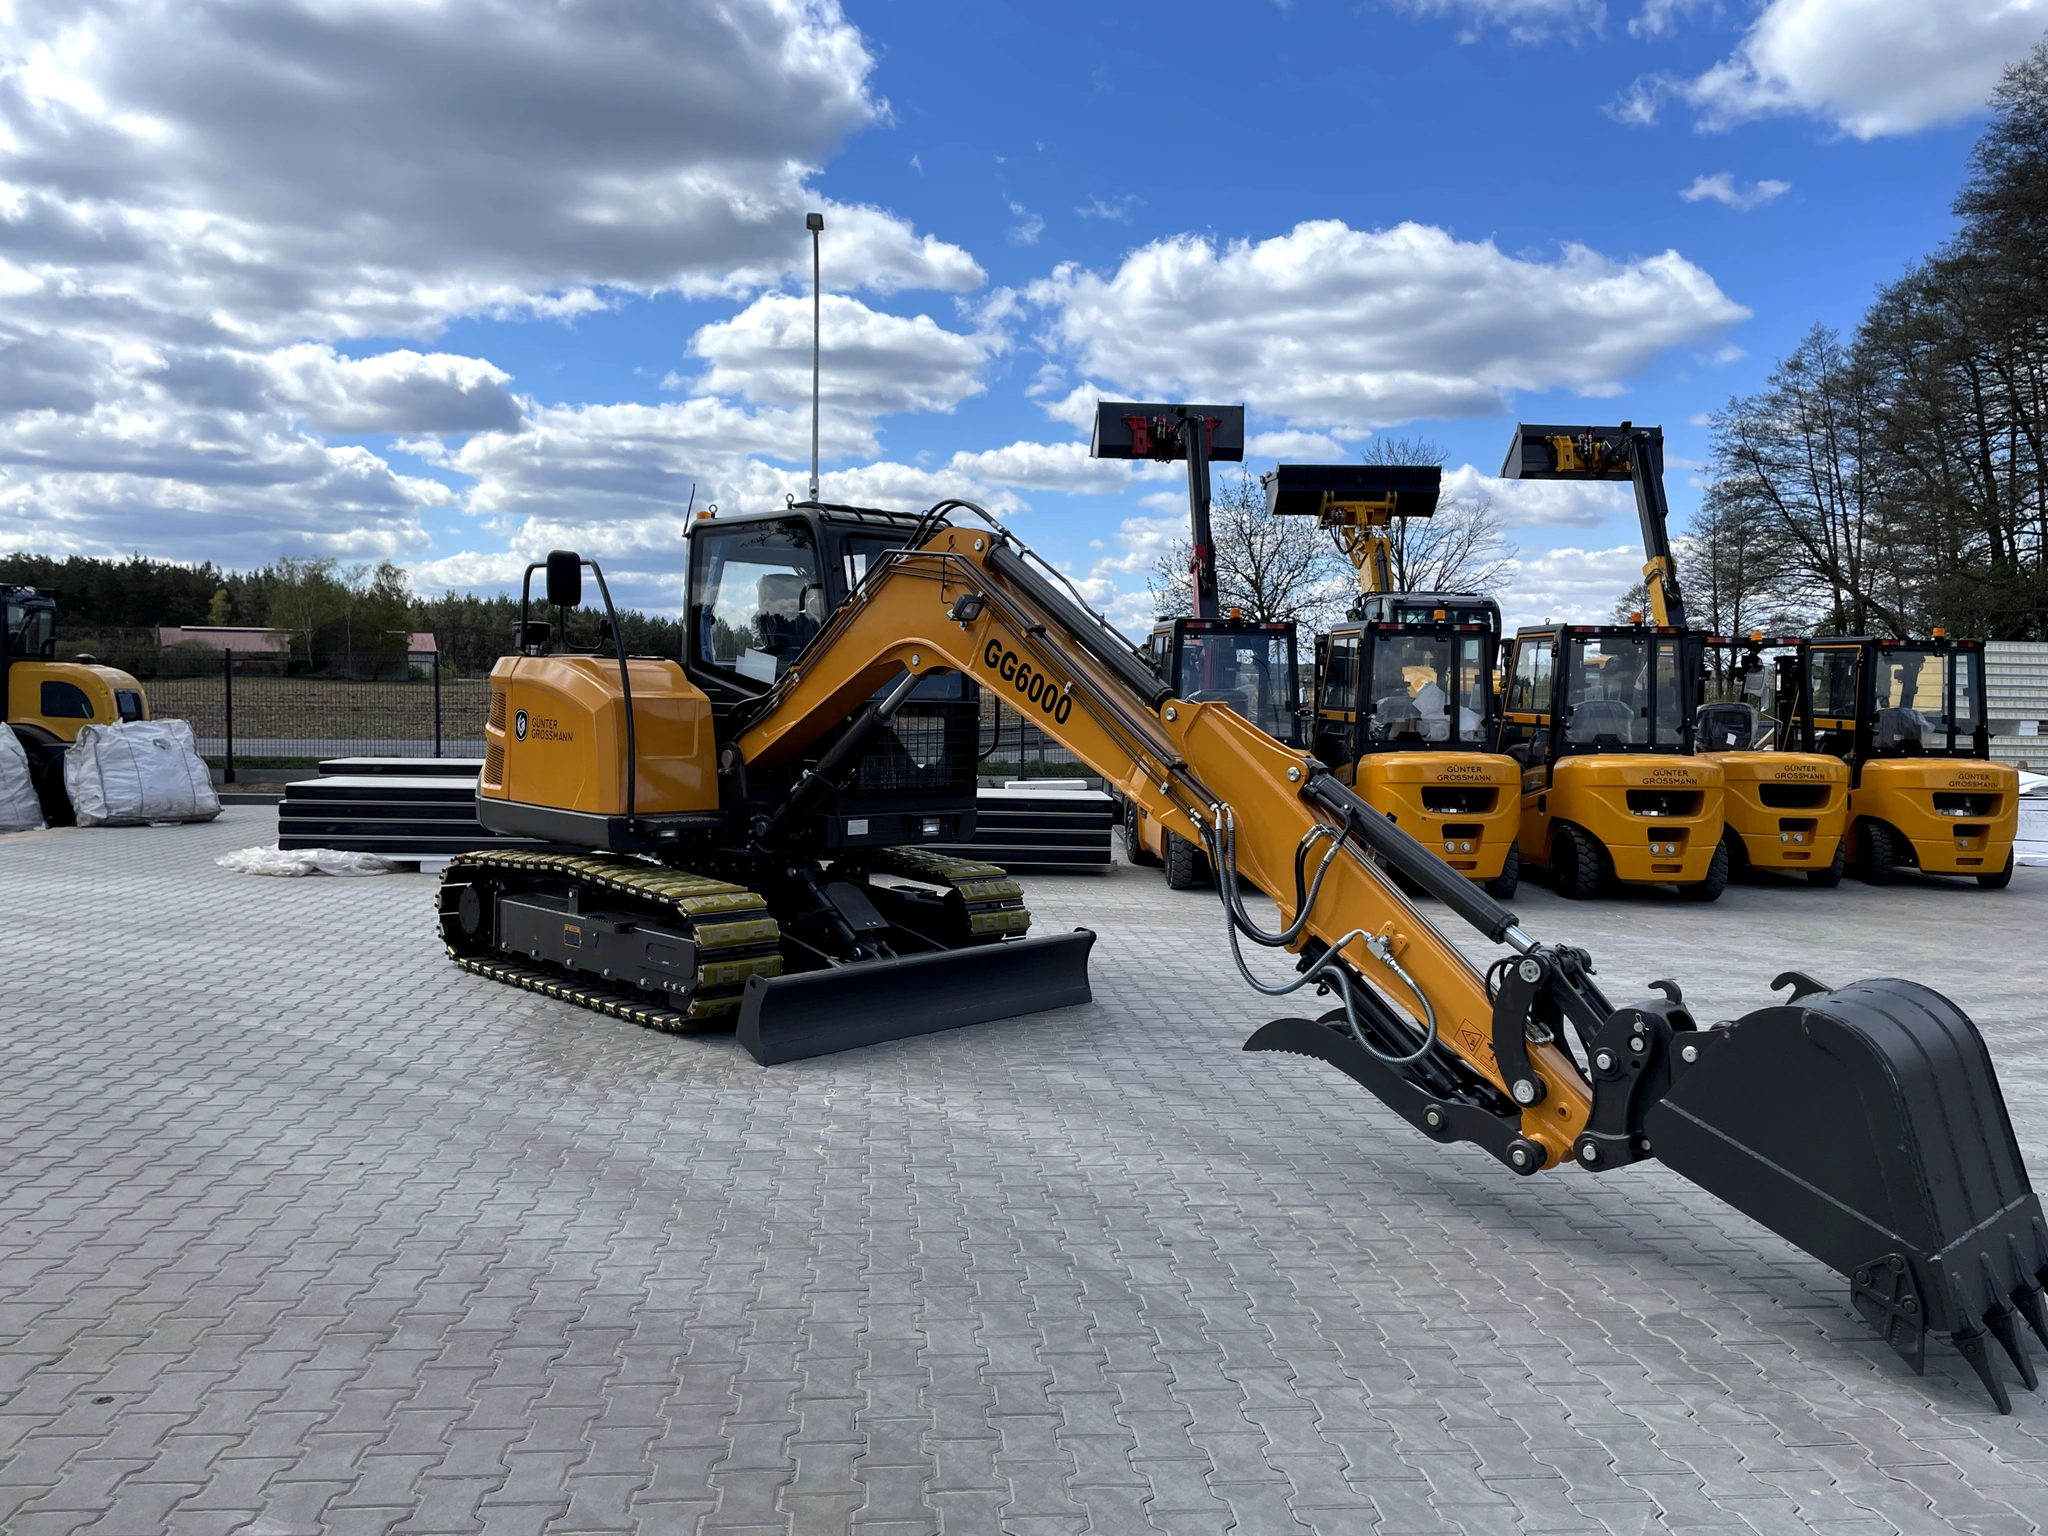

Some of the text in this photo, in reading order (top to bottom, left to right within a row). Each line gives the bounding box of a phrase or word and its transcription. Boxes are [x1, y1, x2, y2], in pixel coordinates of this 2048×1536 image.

[984, 638, 1073, 725] GG6000
[531, 714, 558, 730] GÜNTER
[531, 729, 574, 743] GROSSMANN
[1446, 764, 1482, 773] GÜNTER
[1652, 767, 1689, 777] GÜNTER
[1783, 763, 1817, 773] GÜNTER
[1436, 773, 1492, 782] GROSSMANN
[1642, 777, 1698, 785] GROSSMANN
[1774, 772, 1825, 780] GROSSMANN
[1958, 771, 1990, 781] GÜNTER
[1948, 780, 1998, 789] GROSSMANN
